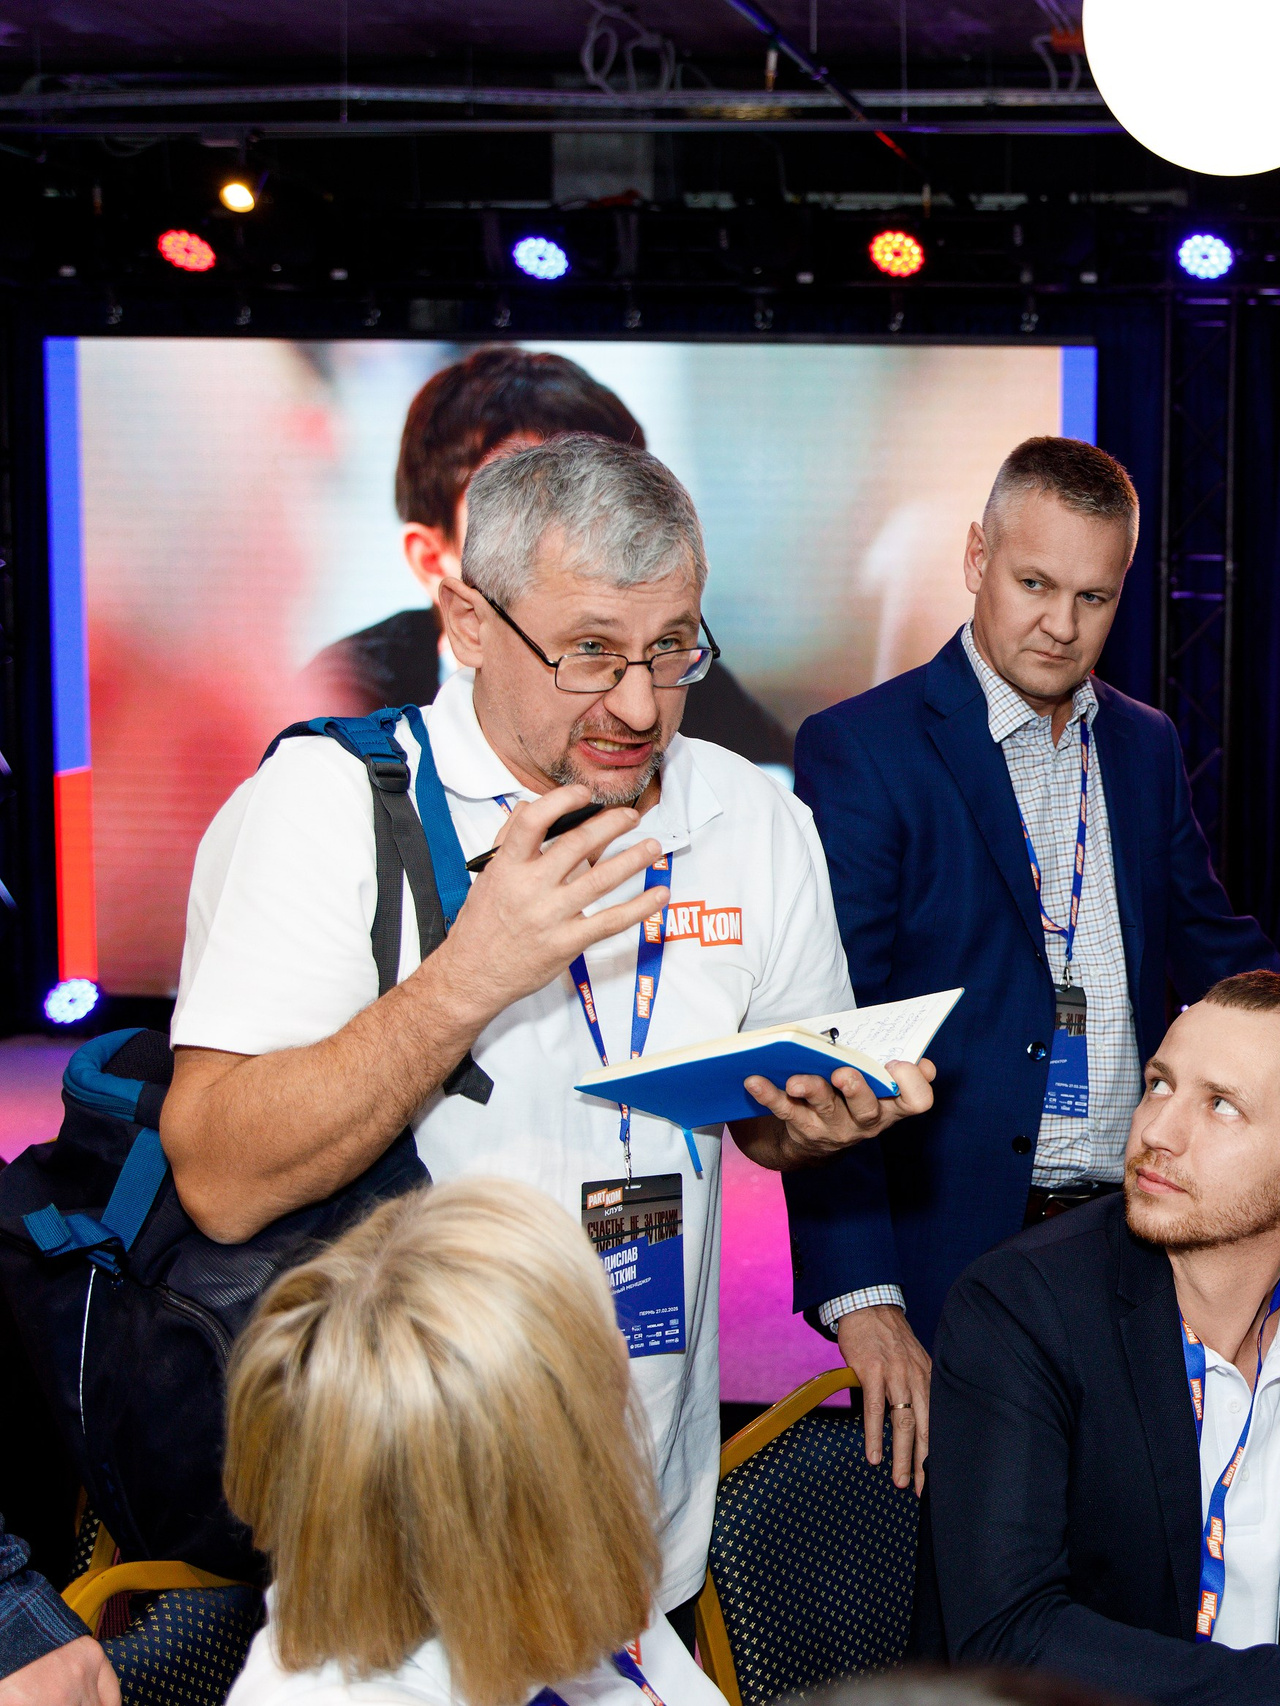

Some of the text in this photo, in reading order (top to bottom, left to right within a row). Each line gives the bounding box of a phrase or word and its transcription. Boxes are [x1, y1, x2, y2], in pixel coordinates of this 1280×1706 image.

[665, 906, 741, 942] ART KOM
[580, 984, 596, 1023] PART KOM
[637, 978, 652, 1016] PART KOM
[588, 1190, 606, 1207] PART
[604, 1204, 623, 1217] КЛУБ
[587, 1217, 625, 1240] СЧАСТЬЕ
[607, 1264, 637, 1288] АТКИН
[1208, 1519, 1223, 1558] PART KOM
[1197, 1592, 1215, 1634] PART KOM
